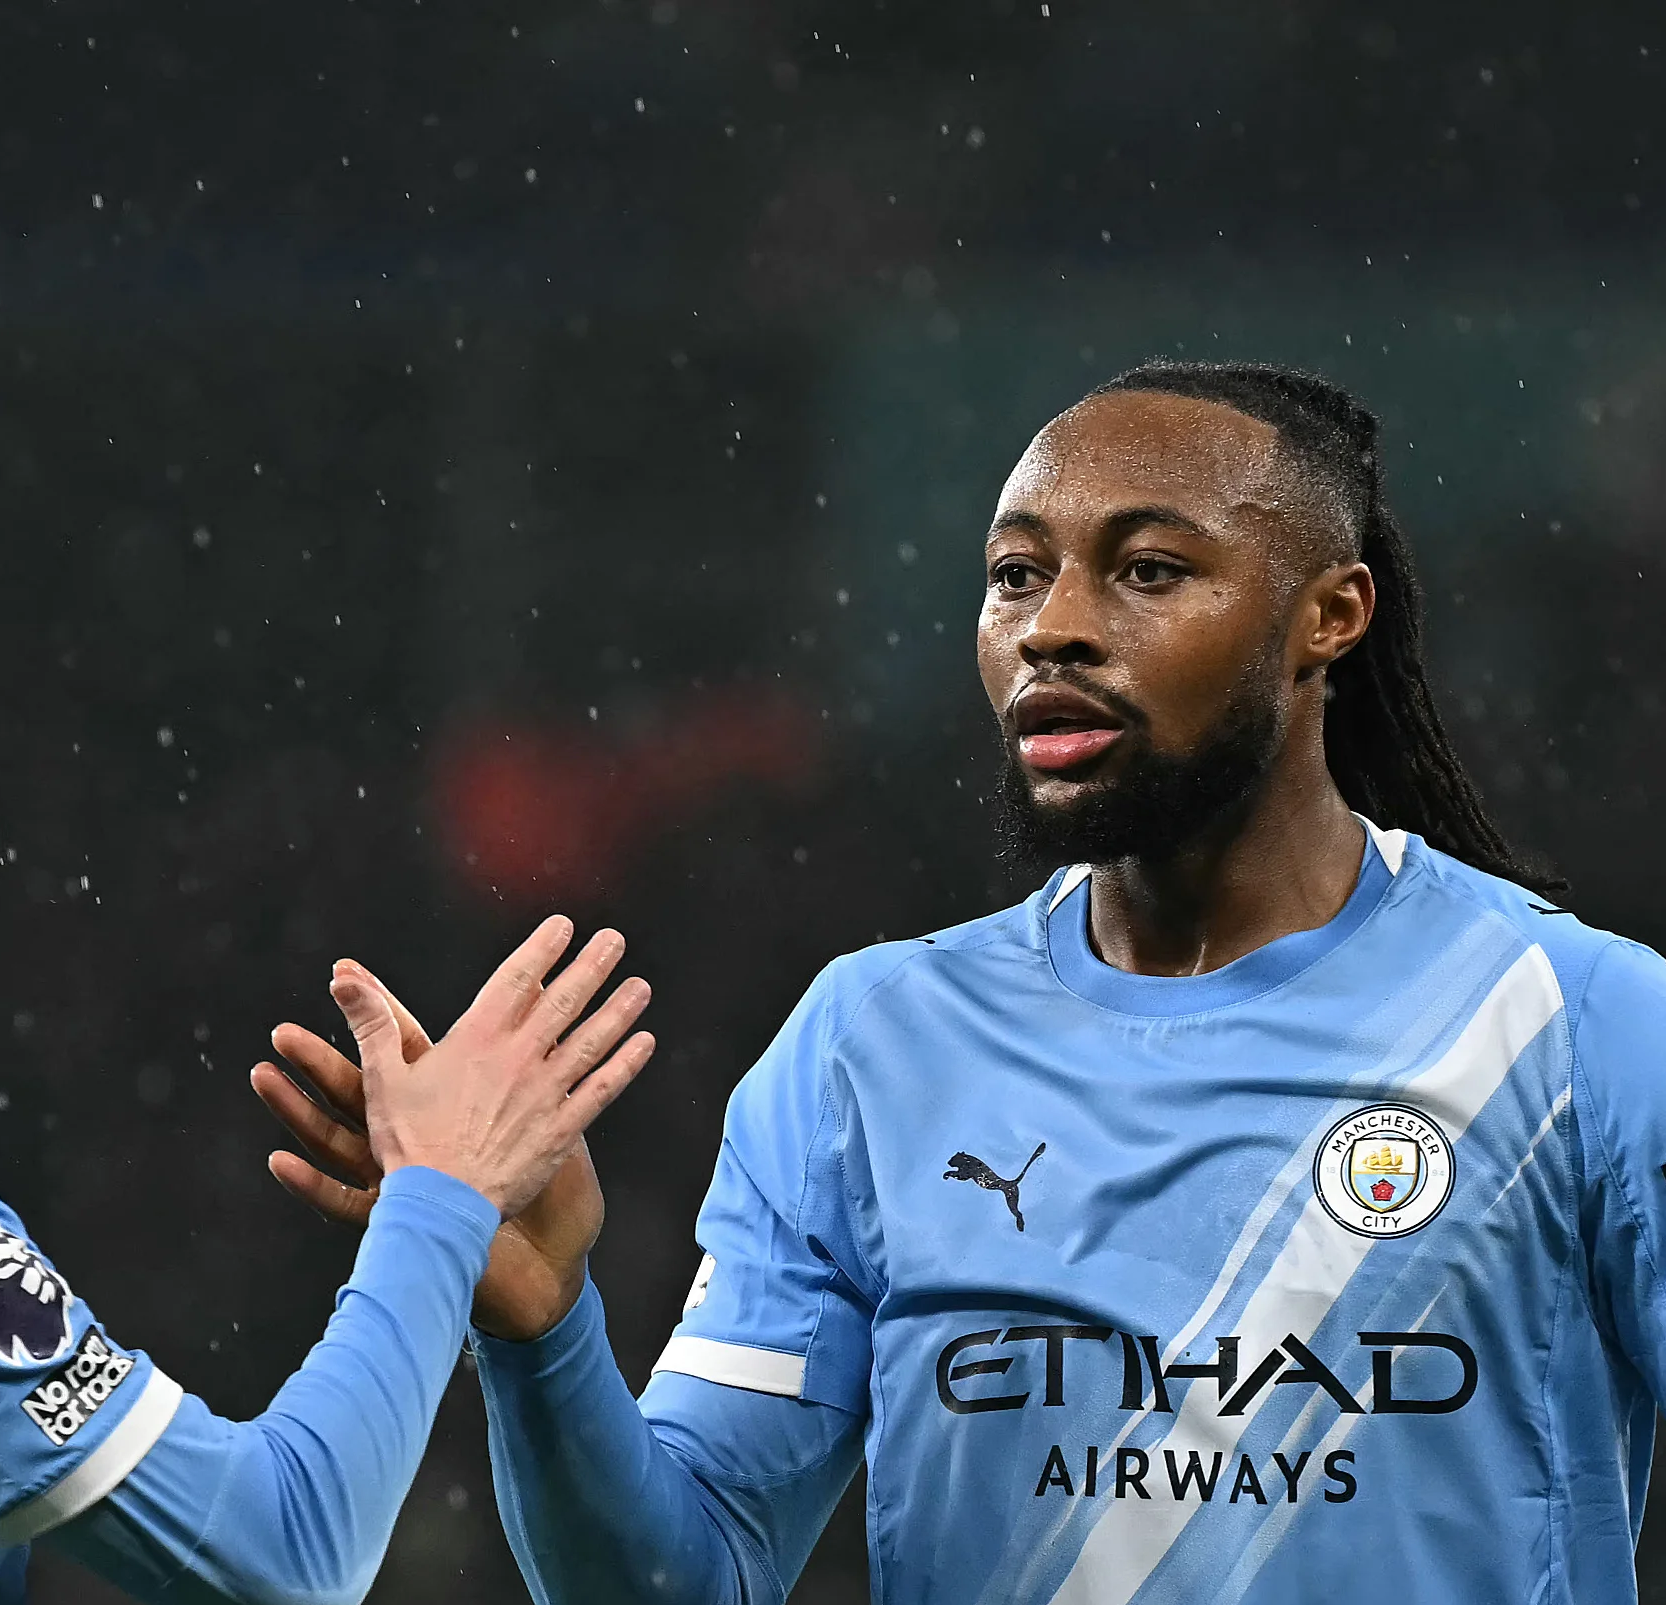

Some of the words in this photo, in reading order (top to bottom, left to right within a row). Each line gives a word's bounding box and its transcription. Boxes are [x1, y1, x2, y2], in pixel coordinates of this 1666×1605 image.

[1331, 1114, 1440, 1155] MANCHESTER
[1362, 1215, 1402, 1228] CITY
[935, 1324, 1479, 1417] ETIHAD
[21, 1380, 70, 1426] No
[41, 1398, 86, 1446] for
[1034, 1443, 1358, 1506] AIRWAYS
